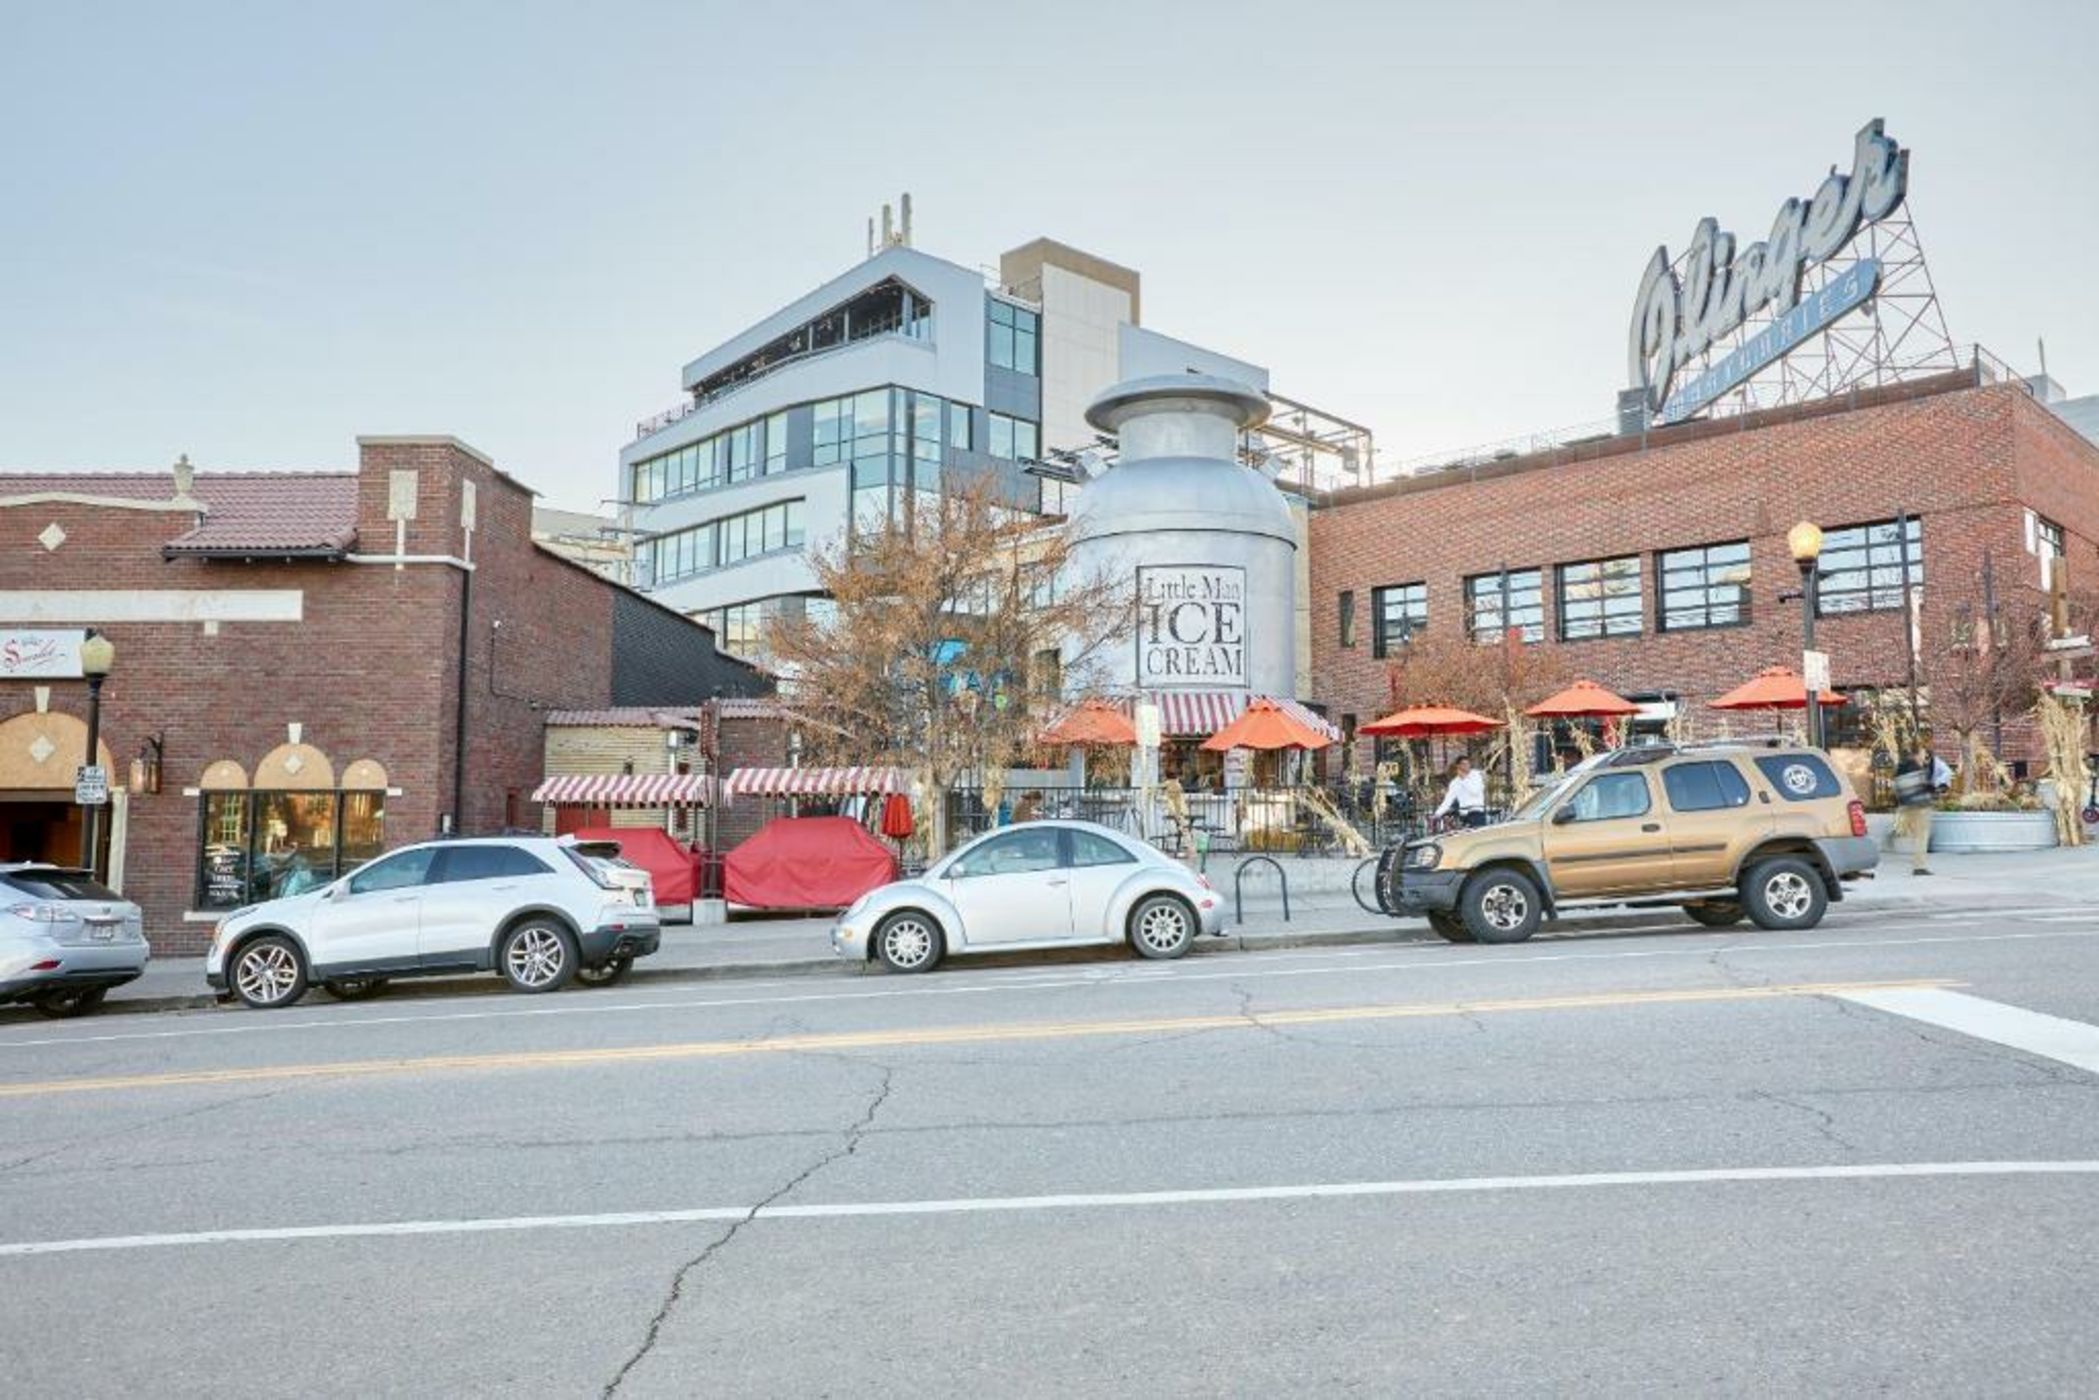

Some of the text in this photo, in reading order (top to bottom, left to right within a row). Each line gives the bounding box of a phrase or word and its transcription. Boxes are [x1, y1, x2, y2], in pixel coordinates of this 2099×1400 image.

[1146, 574, 1241, 600] Little Man
[1145, 601, 1243, 645] ICE
[1147, 647, 1243, 676] CREAM
